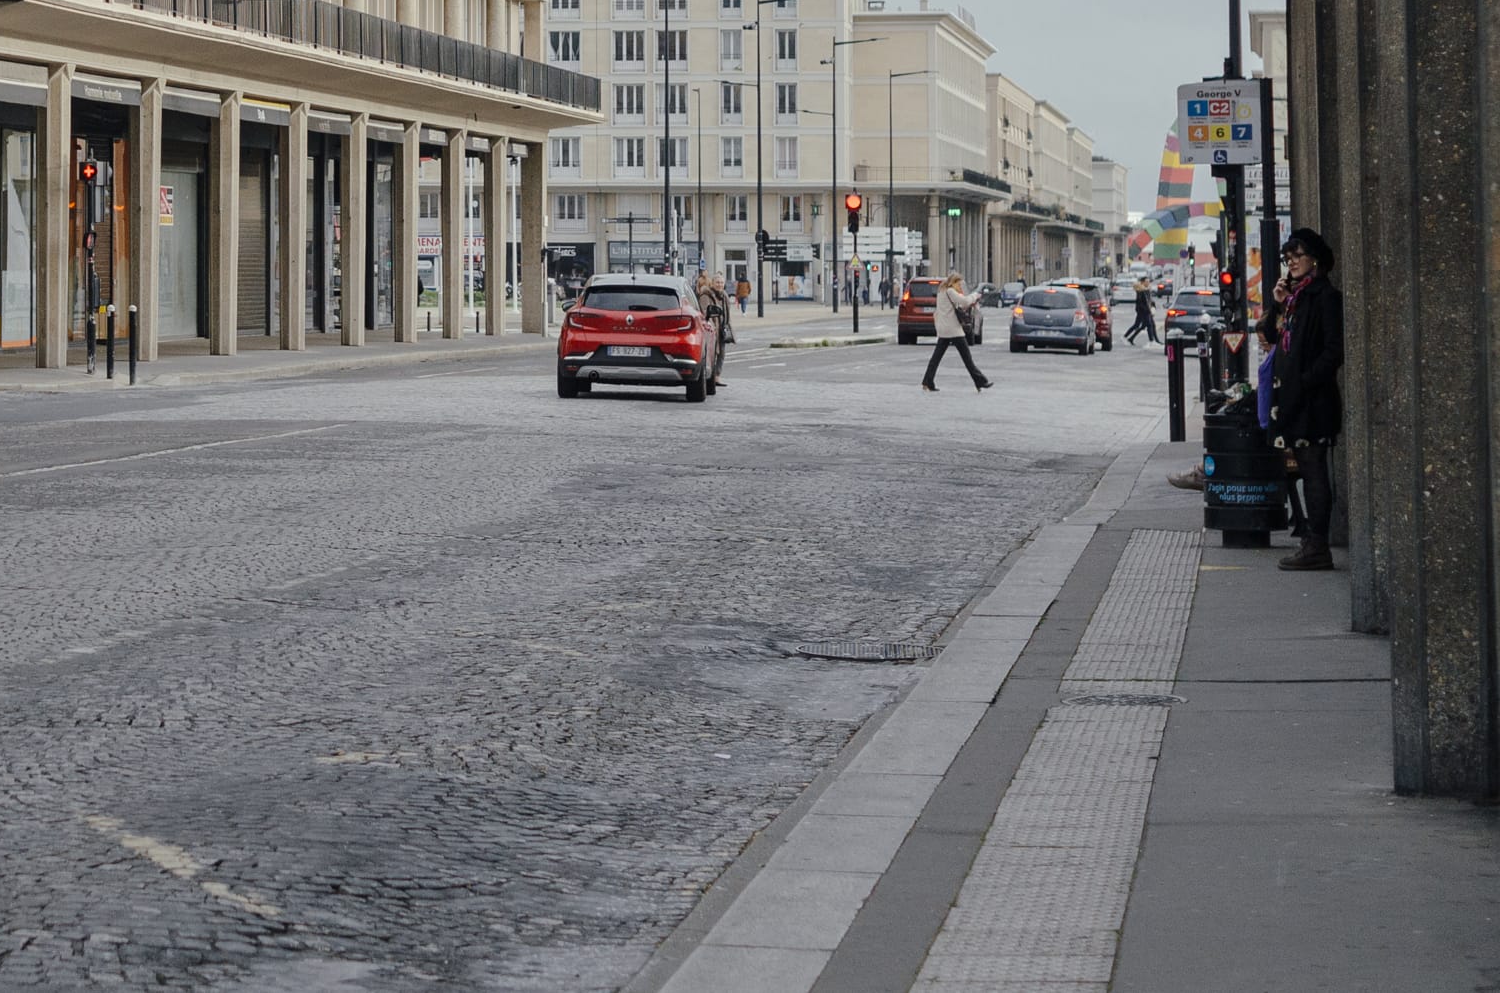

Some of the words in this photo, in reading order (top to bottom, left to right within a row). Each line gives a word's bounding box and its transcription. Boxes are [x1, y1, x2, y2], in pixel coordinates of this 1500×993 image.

[1196, 89, 1232, 99] George
[1234, 89, 1242, 97] V
[1209, 102, 1229, 113] C2
[1194, 128, 1203, 138] 4
[1216, 127, 1225, 138] 6
[1237, 127, 1246, 138] 7
[1226, 485, 1246, 494] pour
